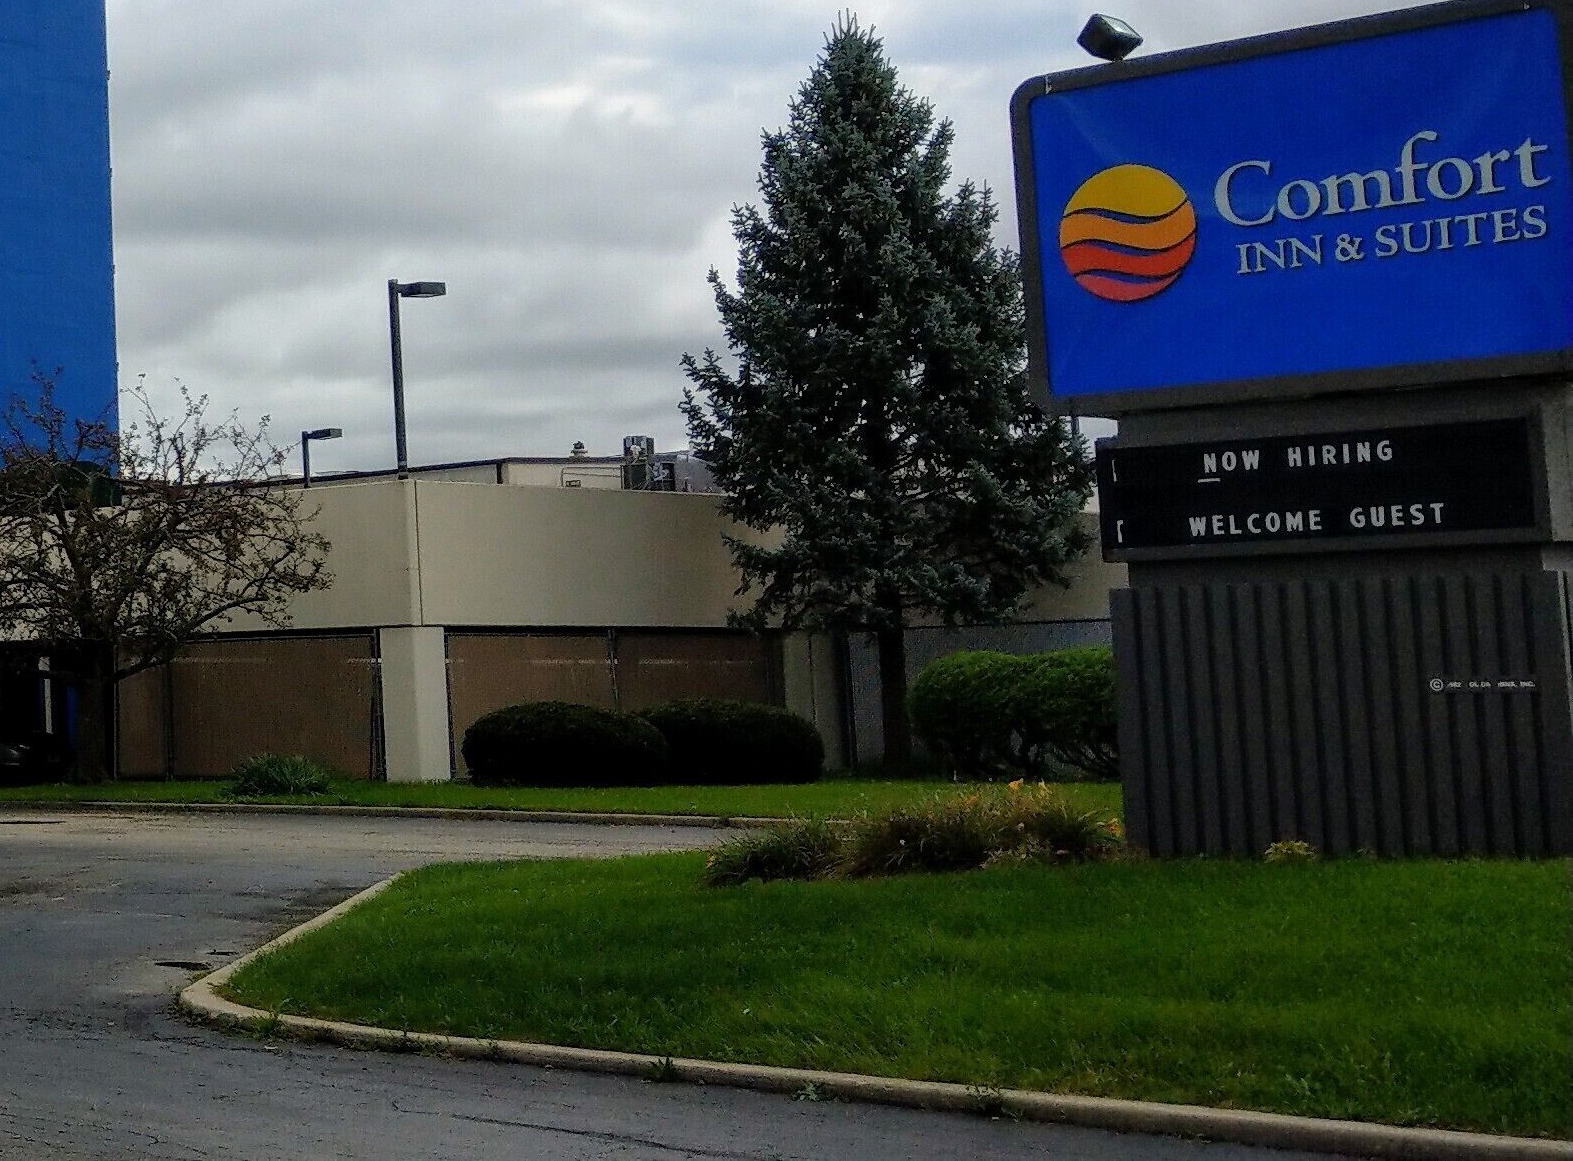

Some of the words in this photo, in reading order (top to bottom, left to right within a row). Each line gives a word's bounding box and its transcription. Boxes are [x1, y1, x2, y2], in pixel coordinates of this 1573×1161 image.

[1214, 130, 1550, 226] Comfort
[1236, 233, 1323, 275] INN
[1335, 233, 1365, 262] &
[1375, 205, 1547, 258] SUITES
[1203, 449, 1260, 473] NOW
[1287, 440, 1393, 468] HIRING
[1189, 509, 1322, 537] WELCOME
[1349, 502, 1445, 528] GUEST
